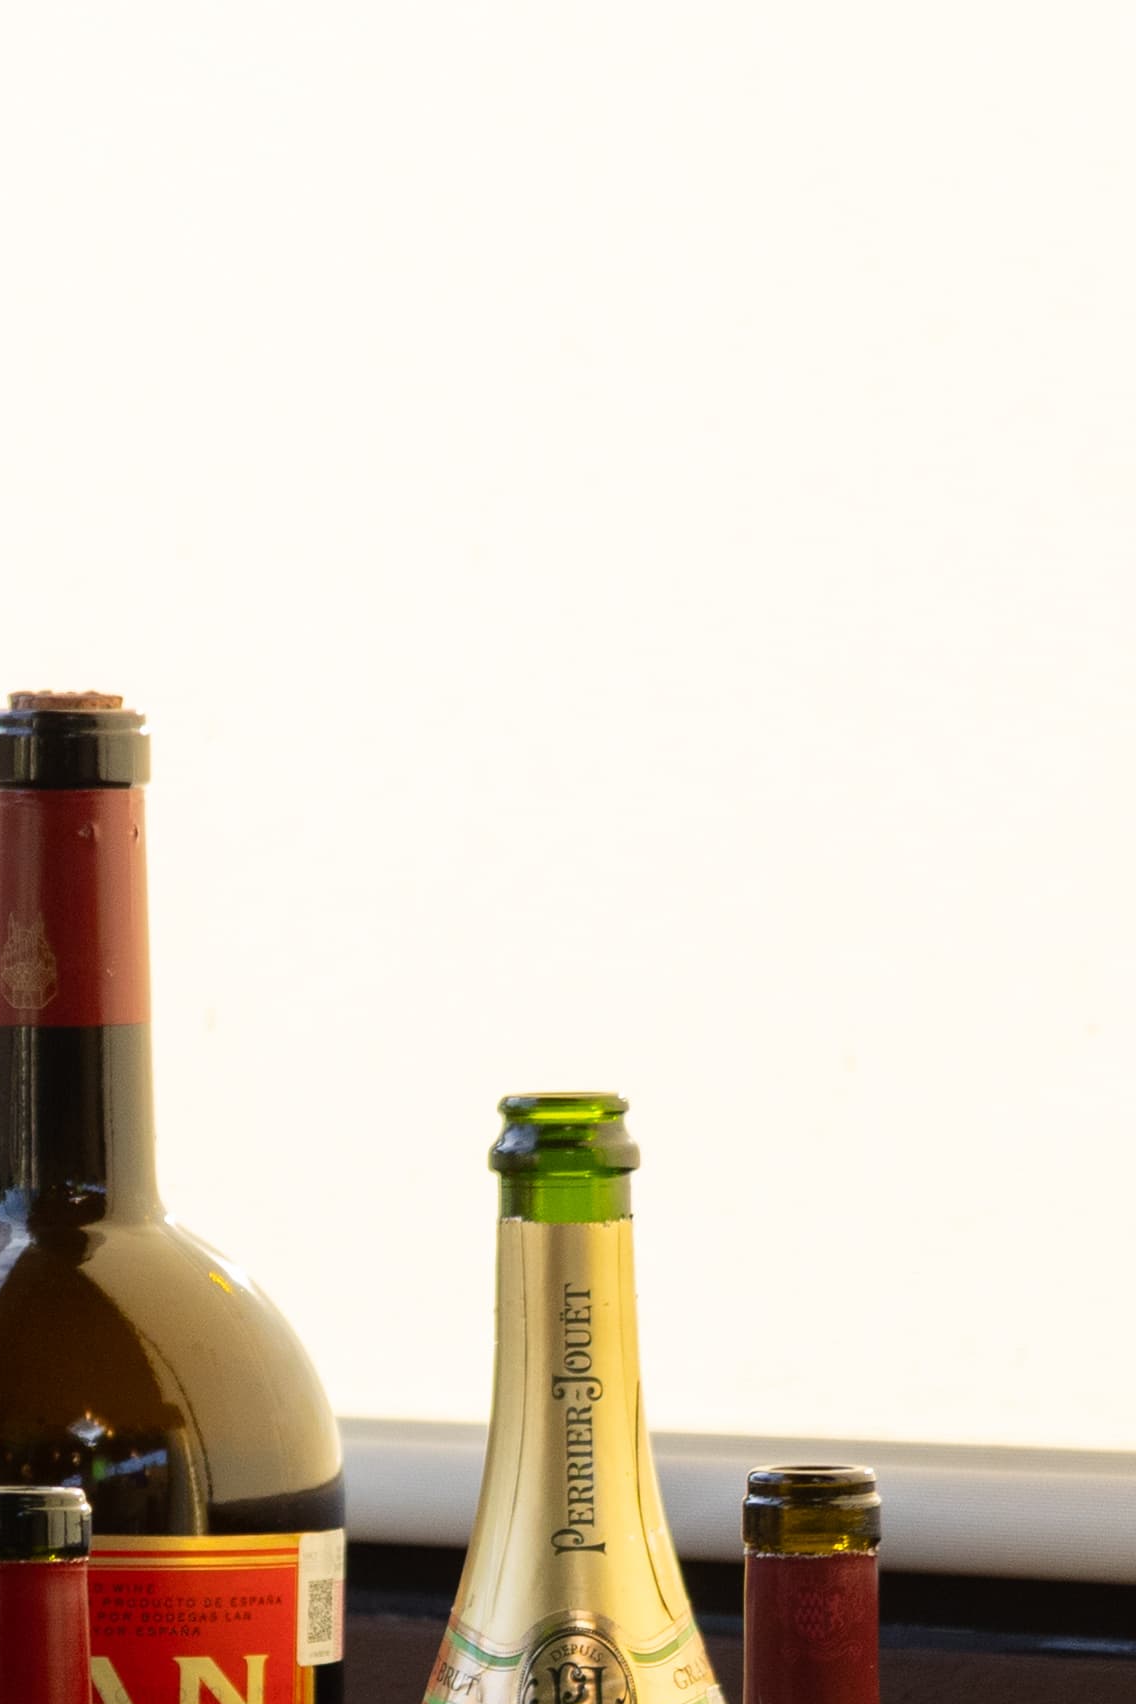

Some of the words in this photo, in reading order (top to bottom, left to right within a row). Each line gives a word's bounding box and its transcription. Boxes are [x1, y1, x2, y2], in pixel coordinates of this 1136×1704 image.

[102, 1597, 196, 1610] PRODUCTO
[203, 1597, 223, 1609] DE
[230, 1595, 283, 1608] ESPAÑA
[141, 1611, 218, 1623] BODEGAS
[224, 1611, 253, 1622] LAN
[135, 1624, 202, 1638] ESPAÑA
[435, 1661, 482, 1697] BRUT
